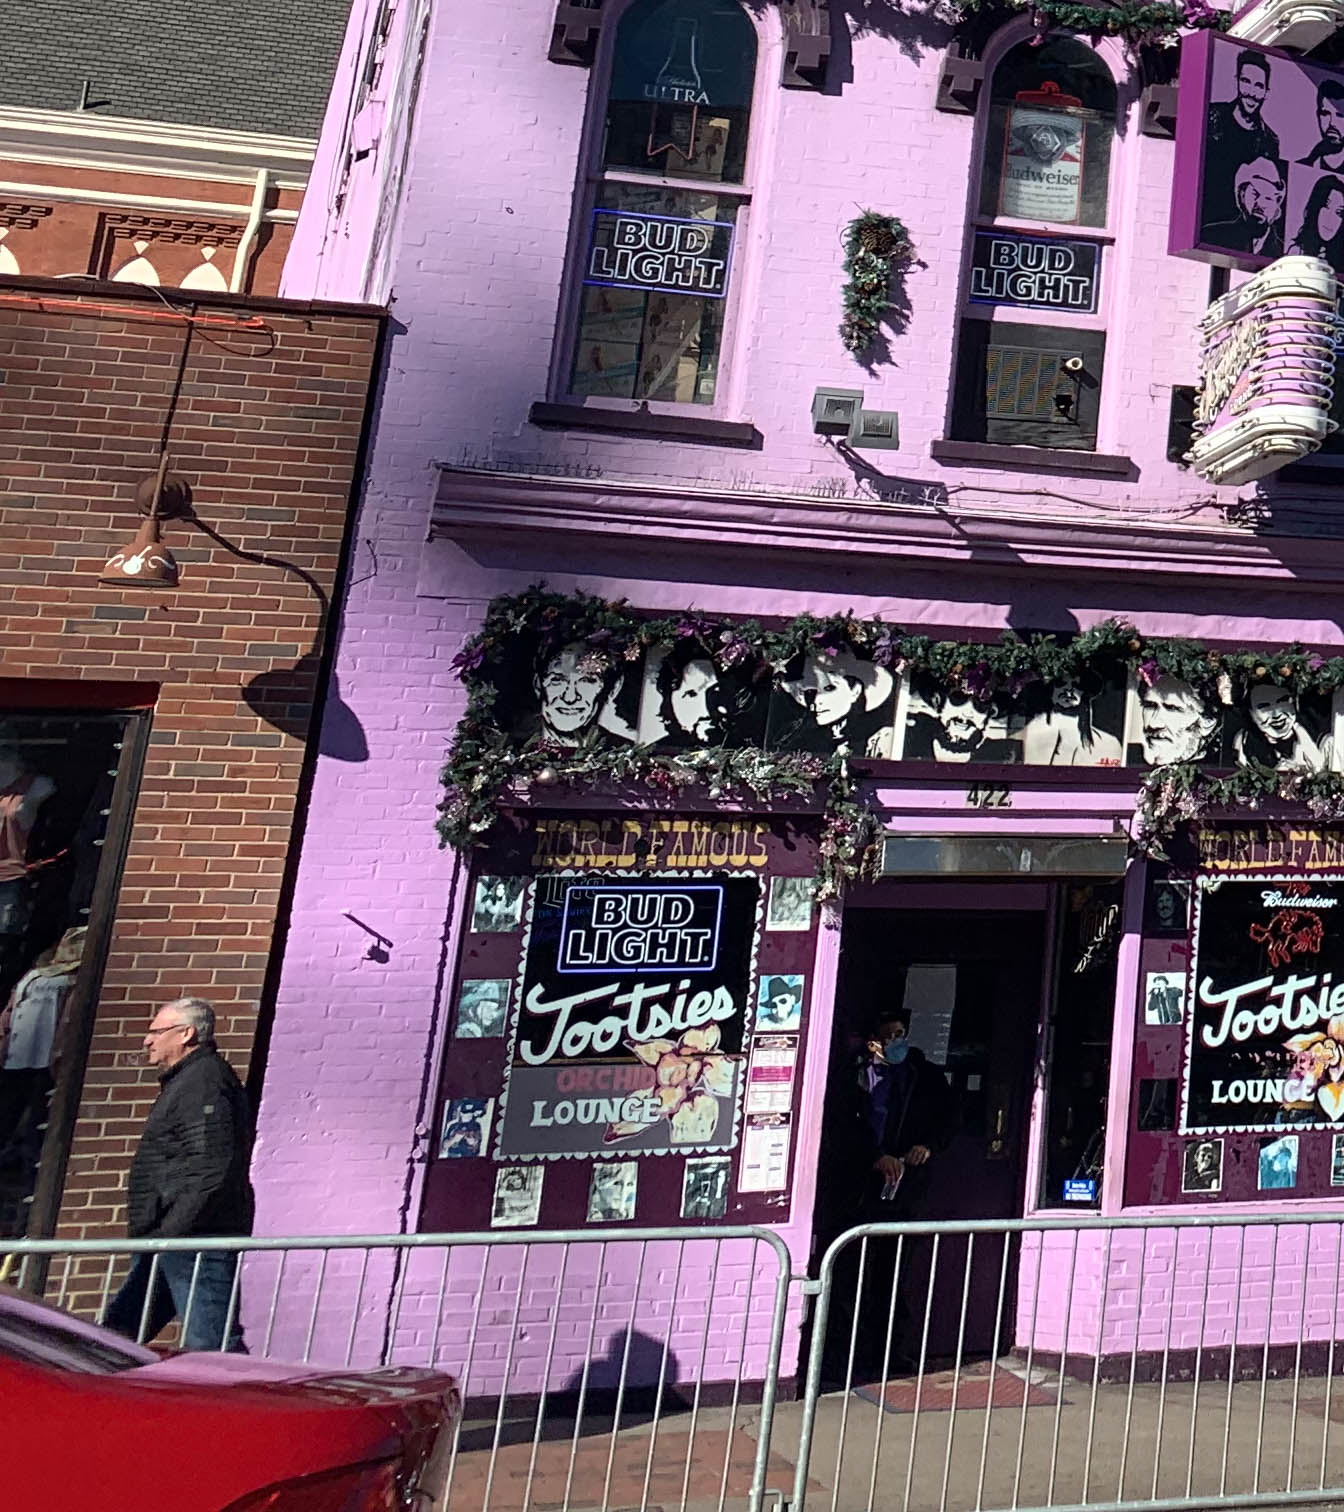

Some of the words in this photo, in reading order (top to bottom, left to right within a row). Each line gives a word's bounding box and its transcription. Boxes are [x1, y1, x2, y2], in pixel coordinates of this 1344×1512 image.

[612, 218, 709, 255] BUD
[989, 239, 1075, 273] BUD
[531, 821, 643, 868] WORLD
[646, 820, 770, 868] FAMOUS
[591, 893, 694, 929] BUD
[1260, 890, 1339, 909] Budweiser
[519, 979, 738, 1065] Tootsies
[1211, 1078, 1316, 1105] LOUNGE
[530, 1096, 662, 1128] LOUNGE
